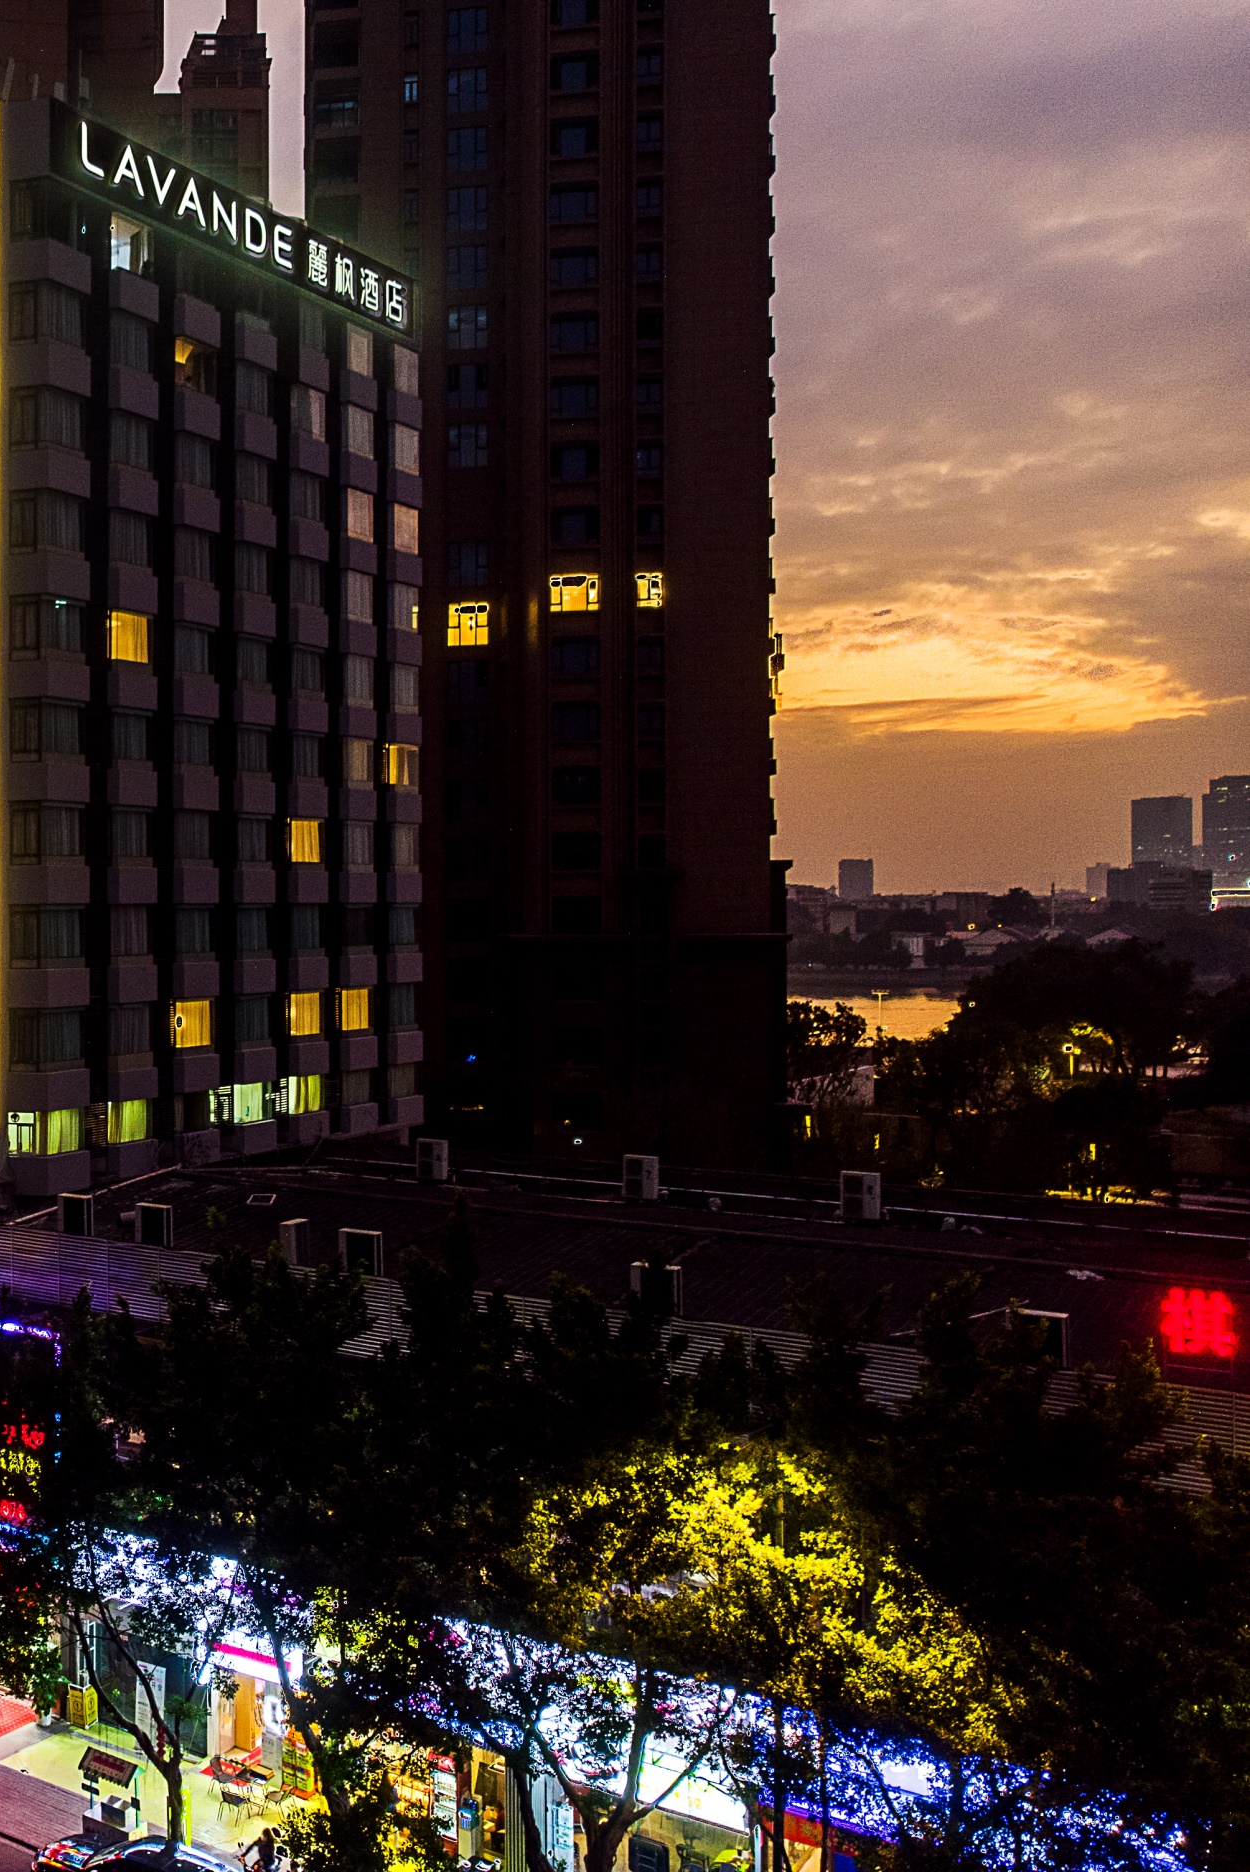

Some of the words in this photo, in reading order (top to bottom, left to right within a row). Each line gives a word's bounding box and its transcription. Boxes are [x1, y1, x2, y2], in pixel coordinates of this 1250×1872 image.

[80, 119, 294, 271] LAVANDE
[307, 237, 407, 325] 麗枫酒店
